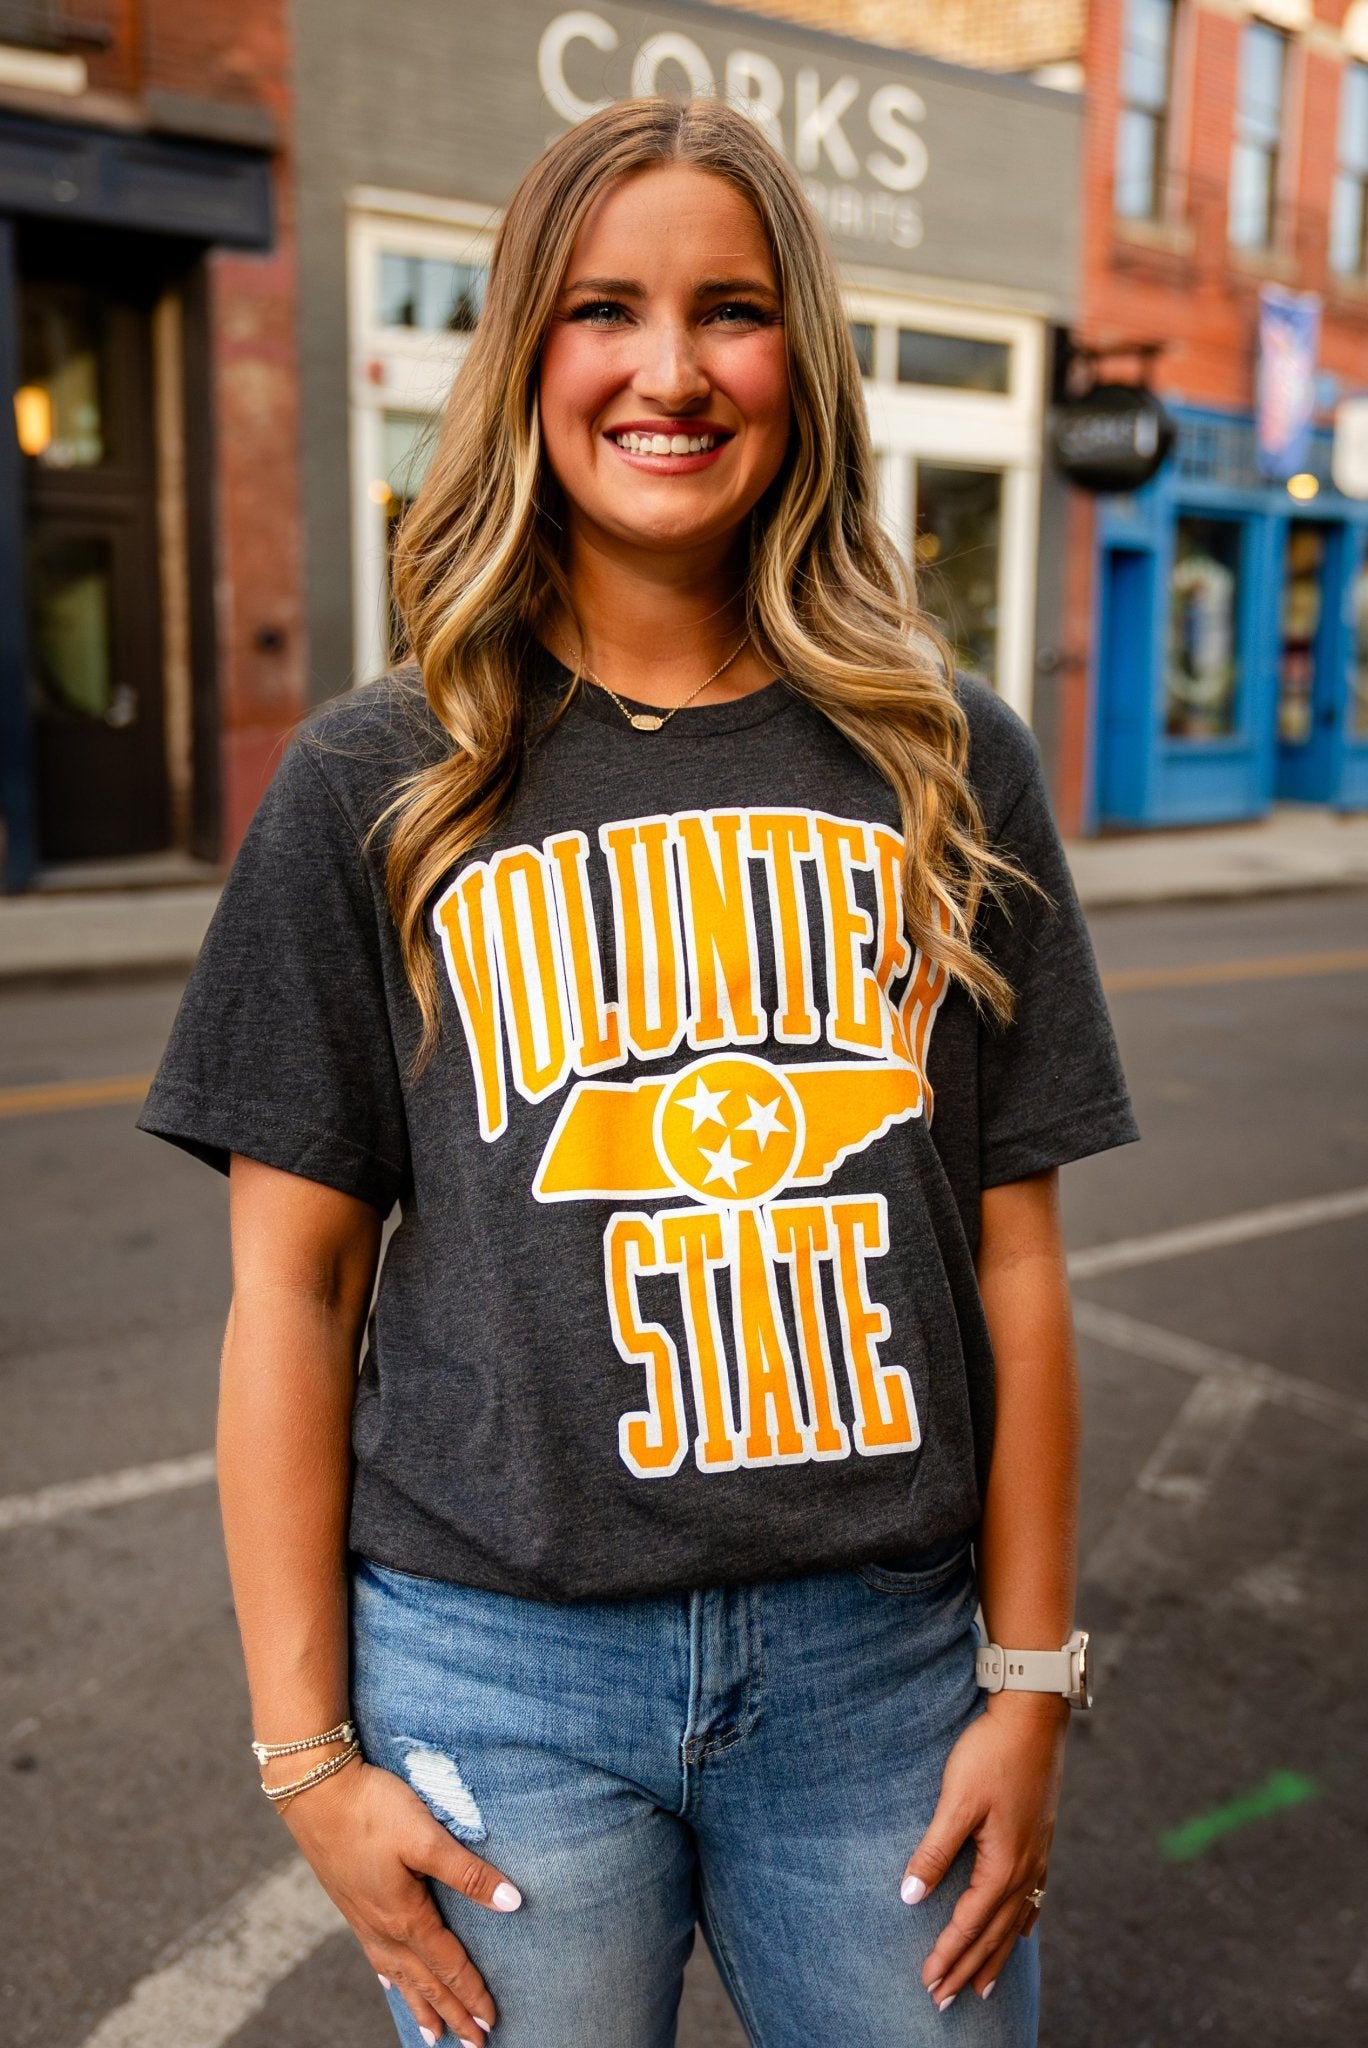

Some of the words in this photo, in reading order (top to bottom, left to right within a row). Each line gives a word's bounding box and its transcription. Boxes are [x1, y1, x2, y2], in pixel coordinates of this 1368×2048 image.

[537, 10, 929, 191] CORKS
[433, 806, 956, 1143] VOLUNTEER
[603, 1192, 921, 1479] STATE
